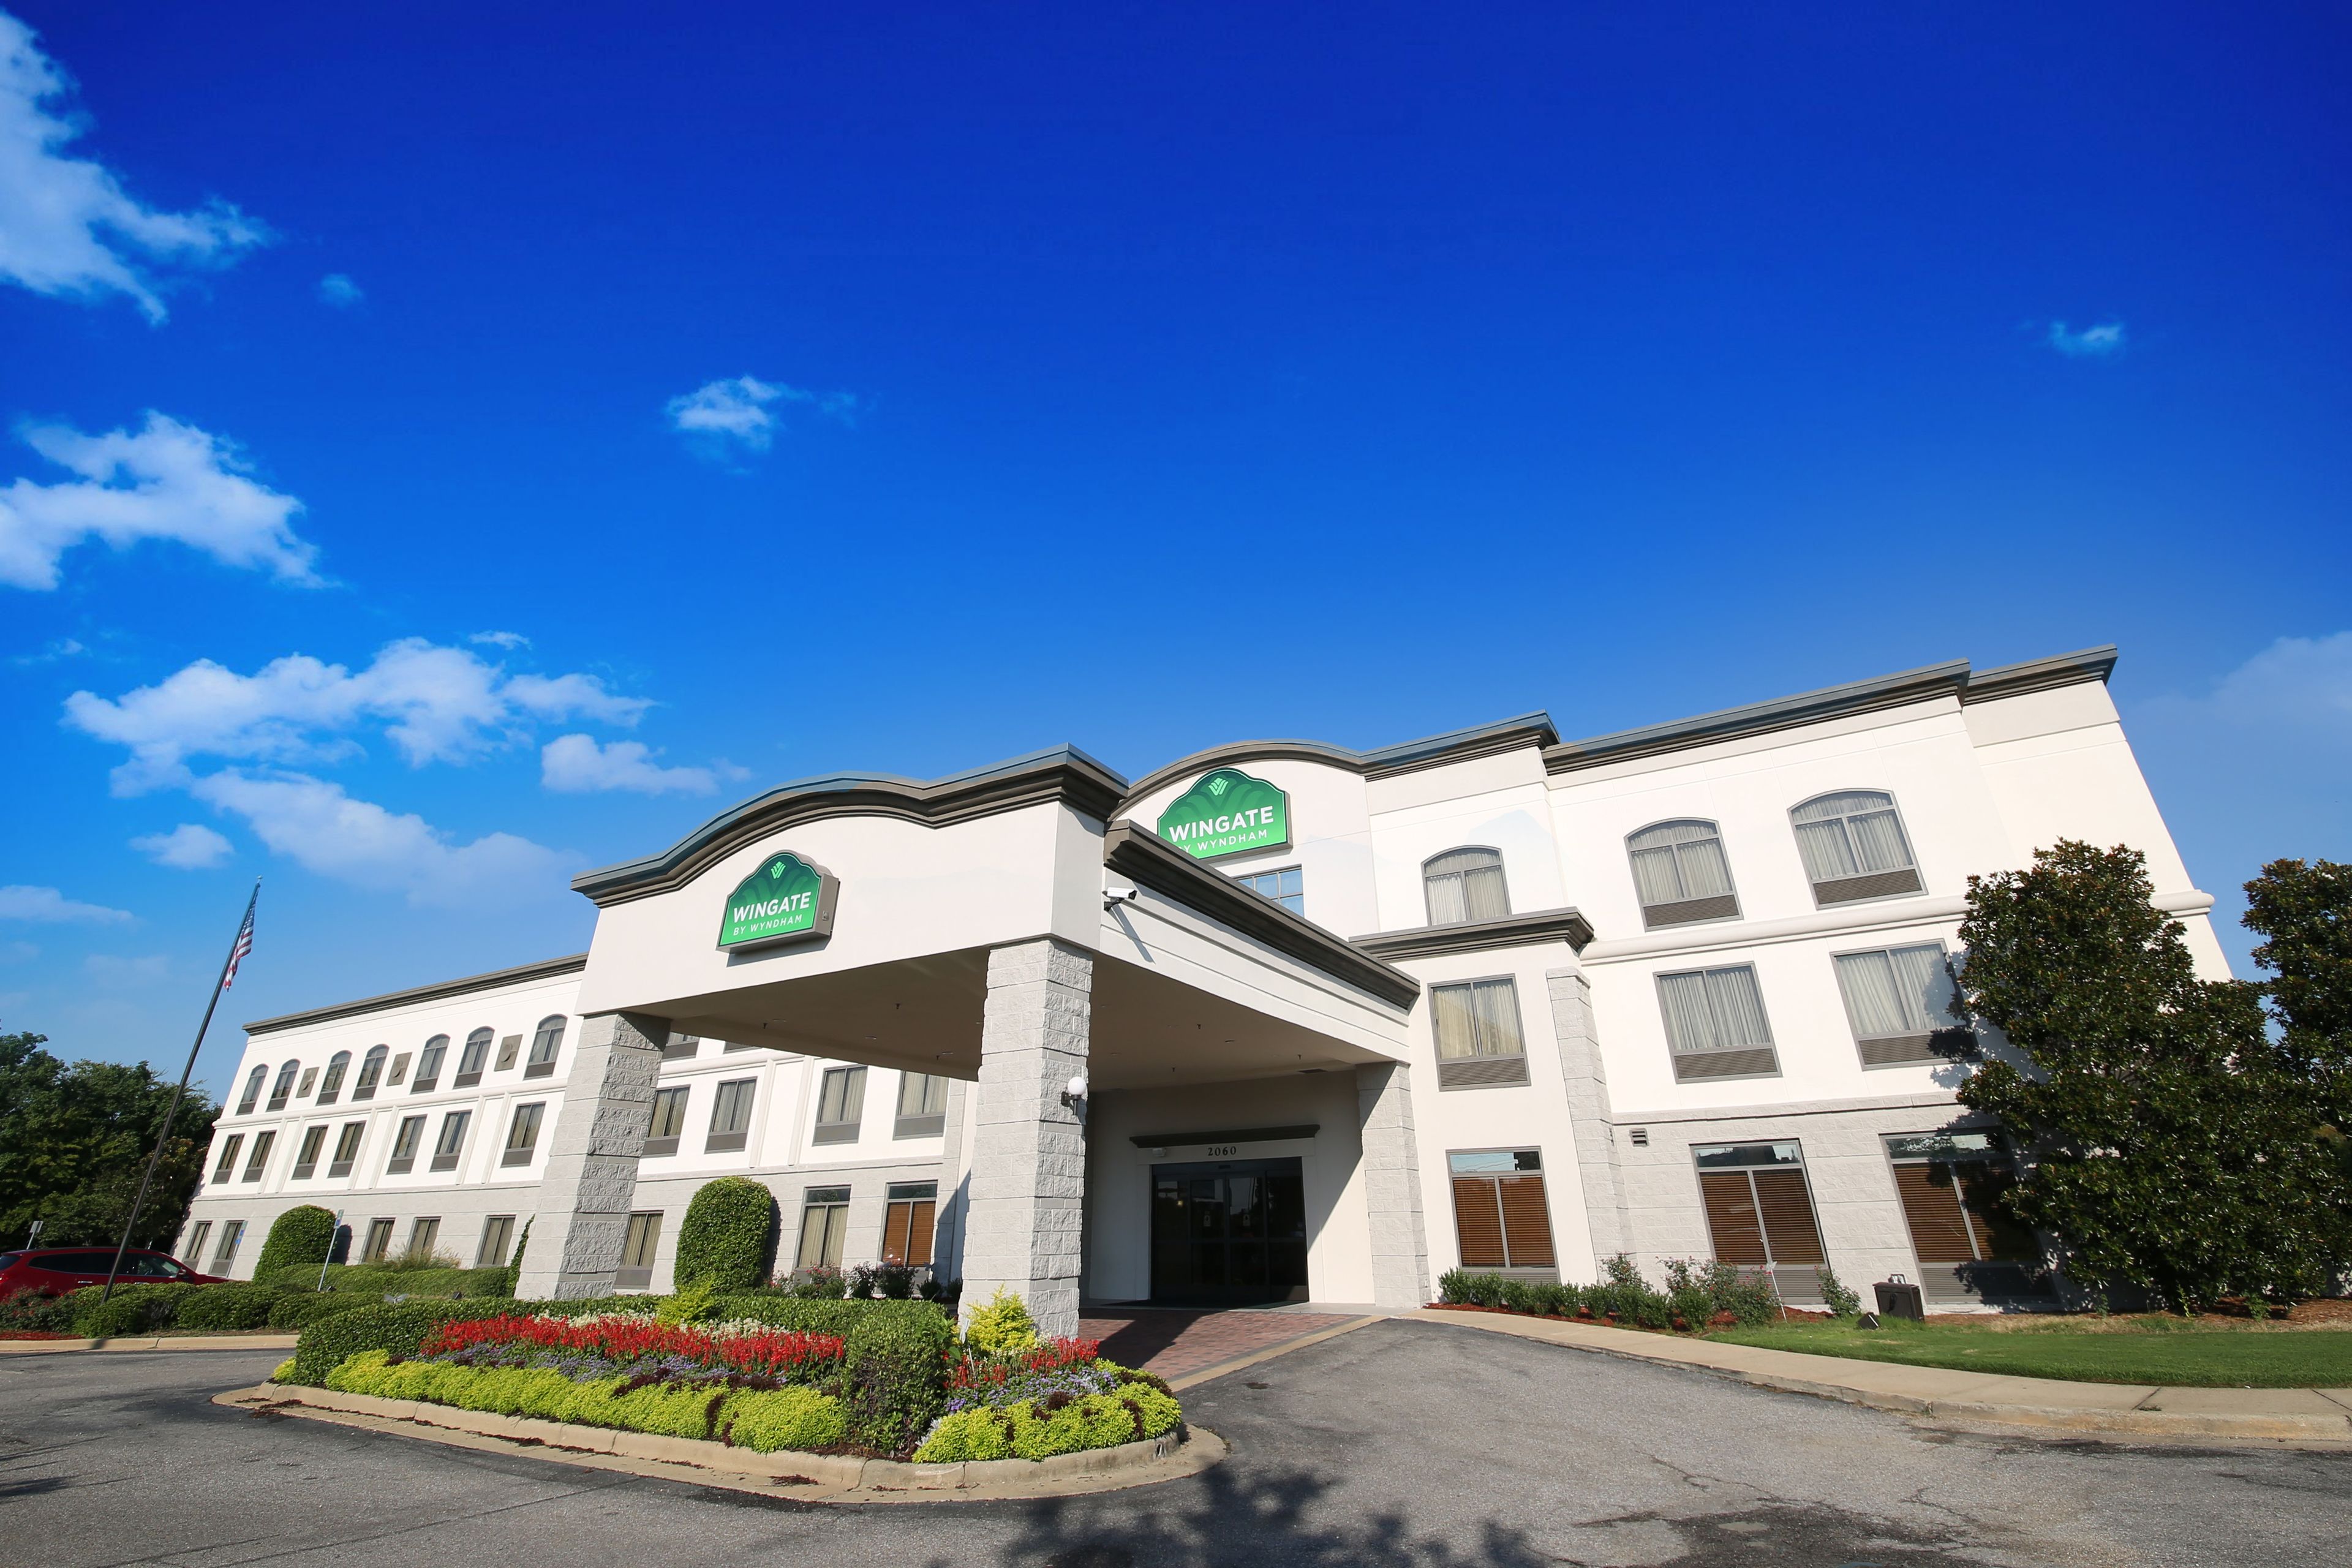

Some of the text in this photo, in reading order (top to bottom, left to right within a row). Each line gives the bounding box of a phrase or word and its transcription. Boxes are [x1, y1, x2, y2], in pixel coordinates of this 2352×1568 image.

[1169, 805, 1274, 843] WINGATE
[1197, 829, 1267, 851] WYNDHAM
[733, 891, 812, 923] WINGATE
[733, 914, 802, 936] BY WYNDHAM
[1208, 1146, 1236, 1156] 2060
